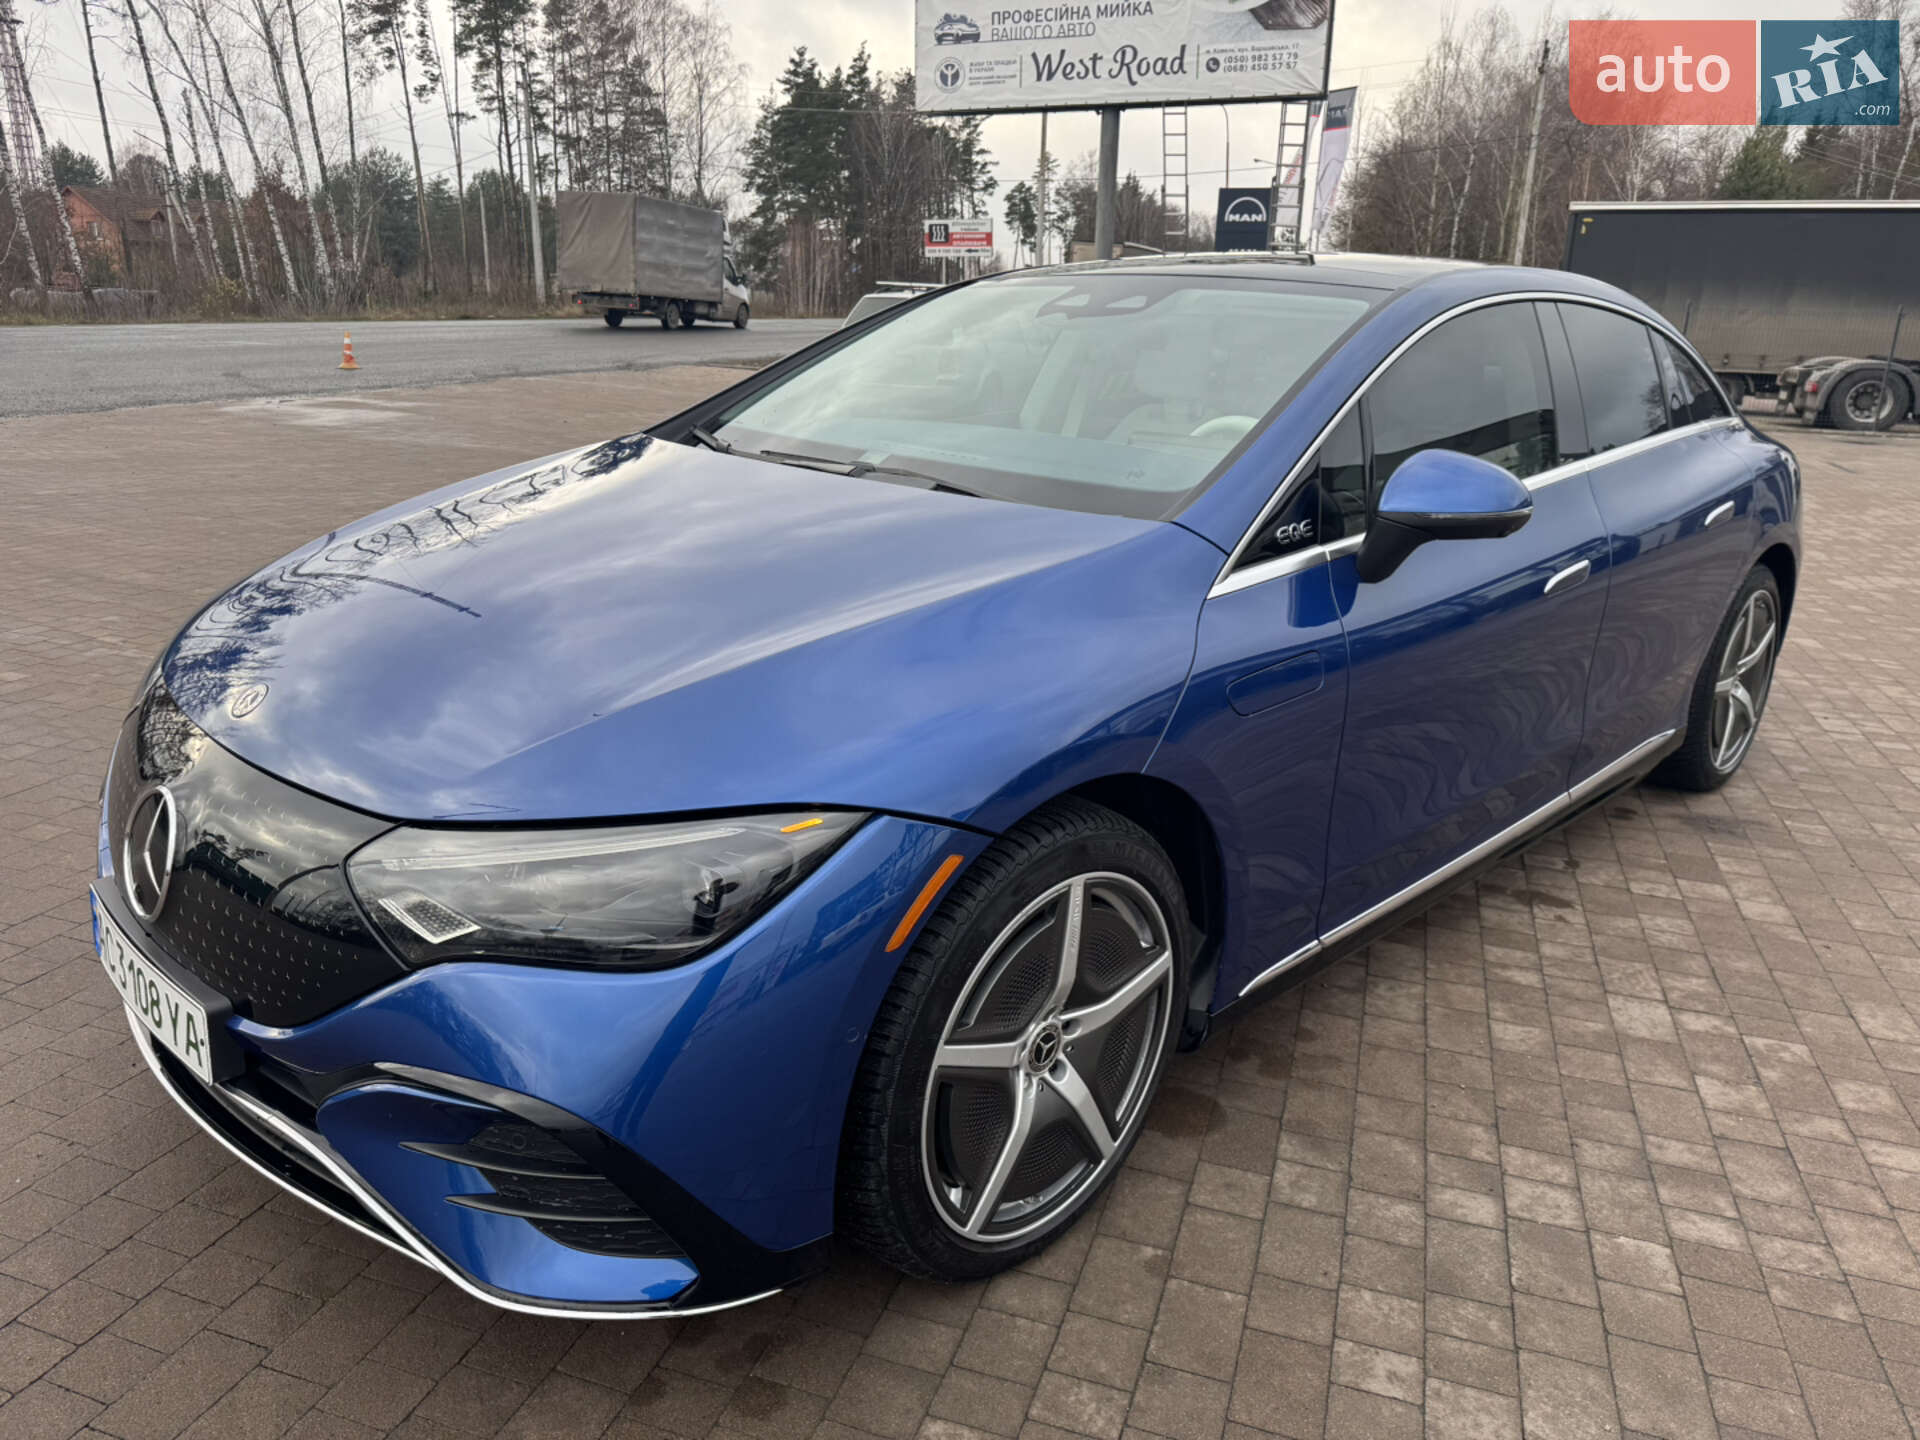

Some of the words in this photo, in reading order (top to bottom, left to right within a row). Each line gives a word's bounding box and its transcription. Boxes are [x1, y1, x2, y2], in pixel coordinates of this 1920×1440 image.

[991, 4, 1092, 25] ПРОФЕСІЙНА
[1096, 0, 1153, 19] МИЙКА
[991, 24, 1053, 41] ВАШОГО
[1056, 21, 1096, 38] АВТО
[1031, 49, 1103, 82] West
[1108, 44, 1187, 86] Road
[1228, 213, 1263, 222] MAN
[1276, 519, 1313, 544] EQE
